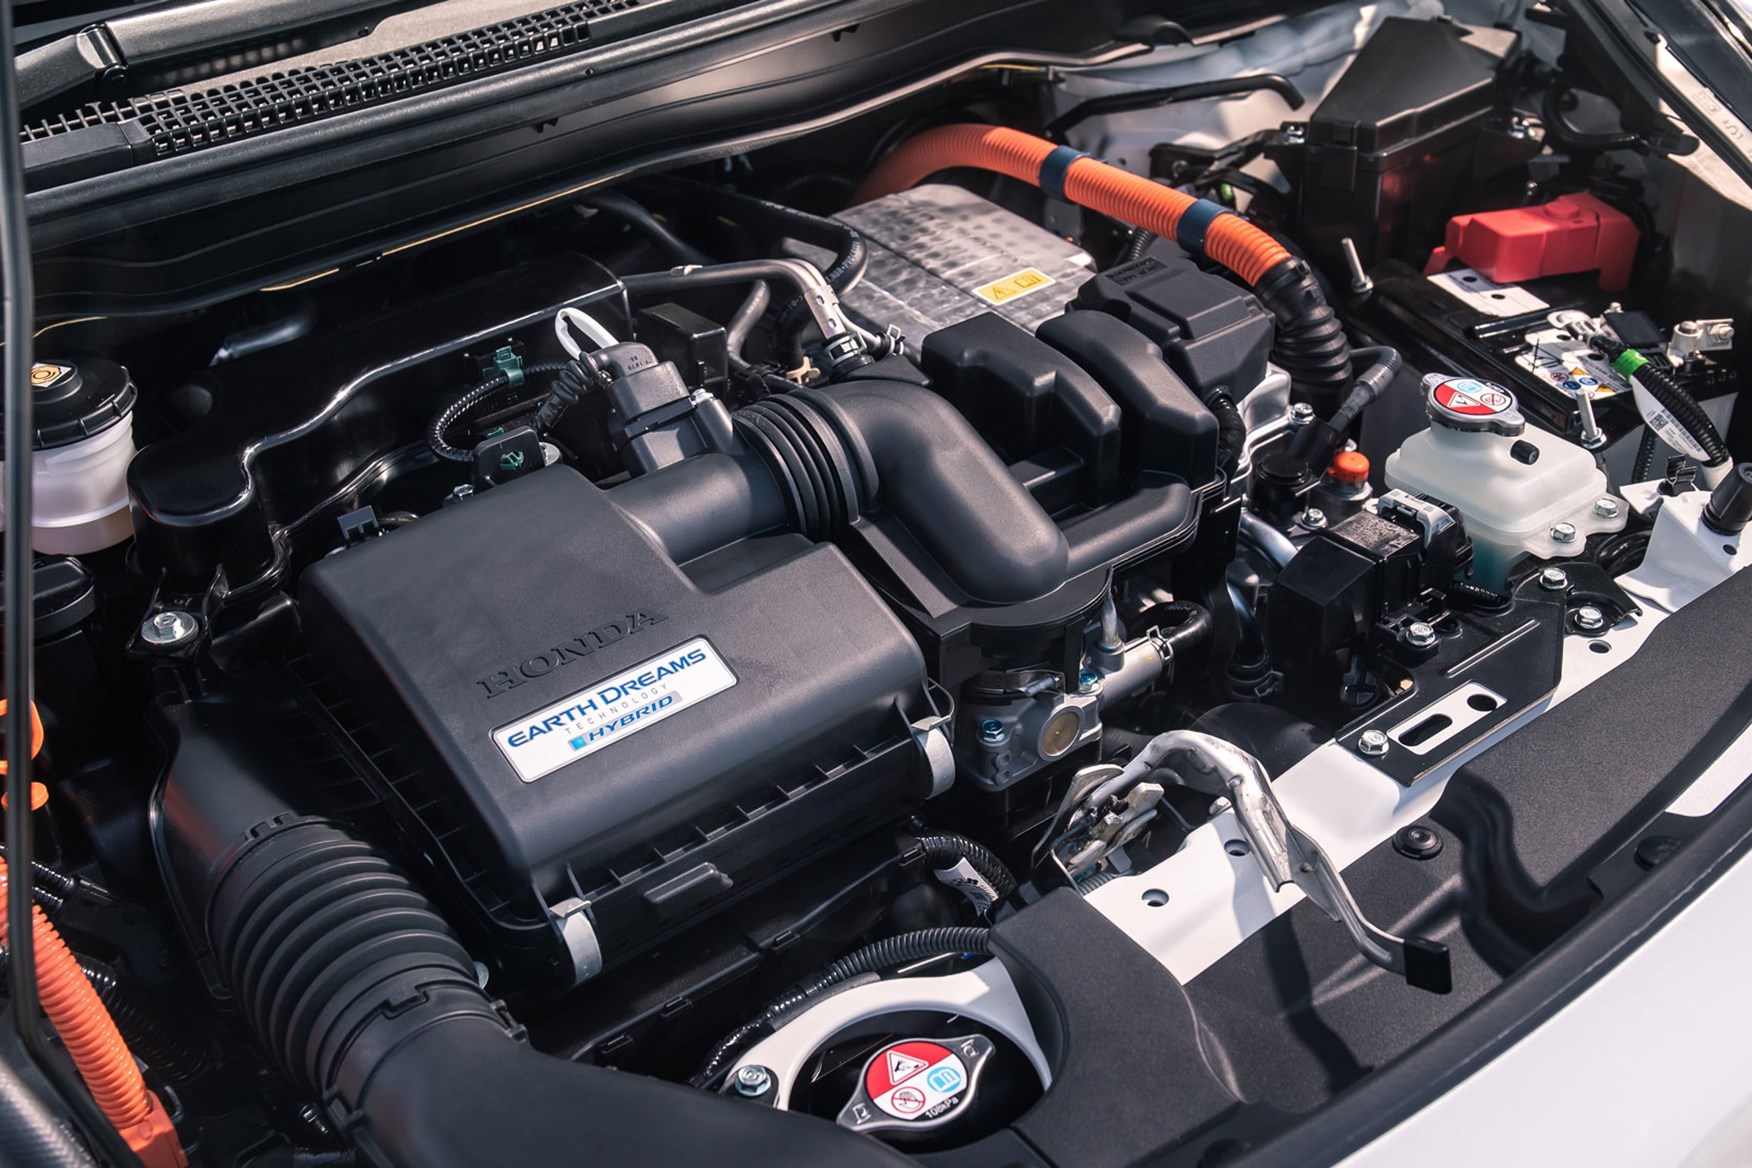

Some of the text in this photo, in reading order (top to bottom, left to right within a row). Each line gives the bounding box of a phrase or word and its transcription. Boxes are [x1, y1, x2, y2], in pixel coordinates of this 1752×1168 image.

[476, 612, 669, 698] HONDA
[507, 648, 706, 748] EARTH DREAMS
[564, 682, 668, 735] TECHNOLOGY
[588, 695, 673, 741] HYBRID
